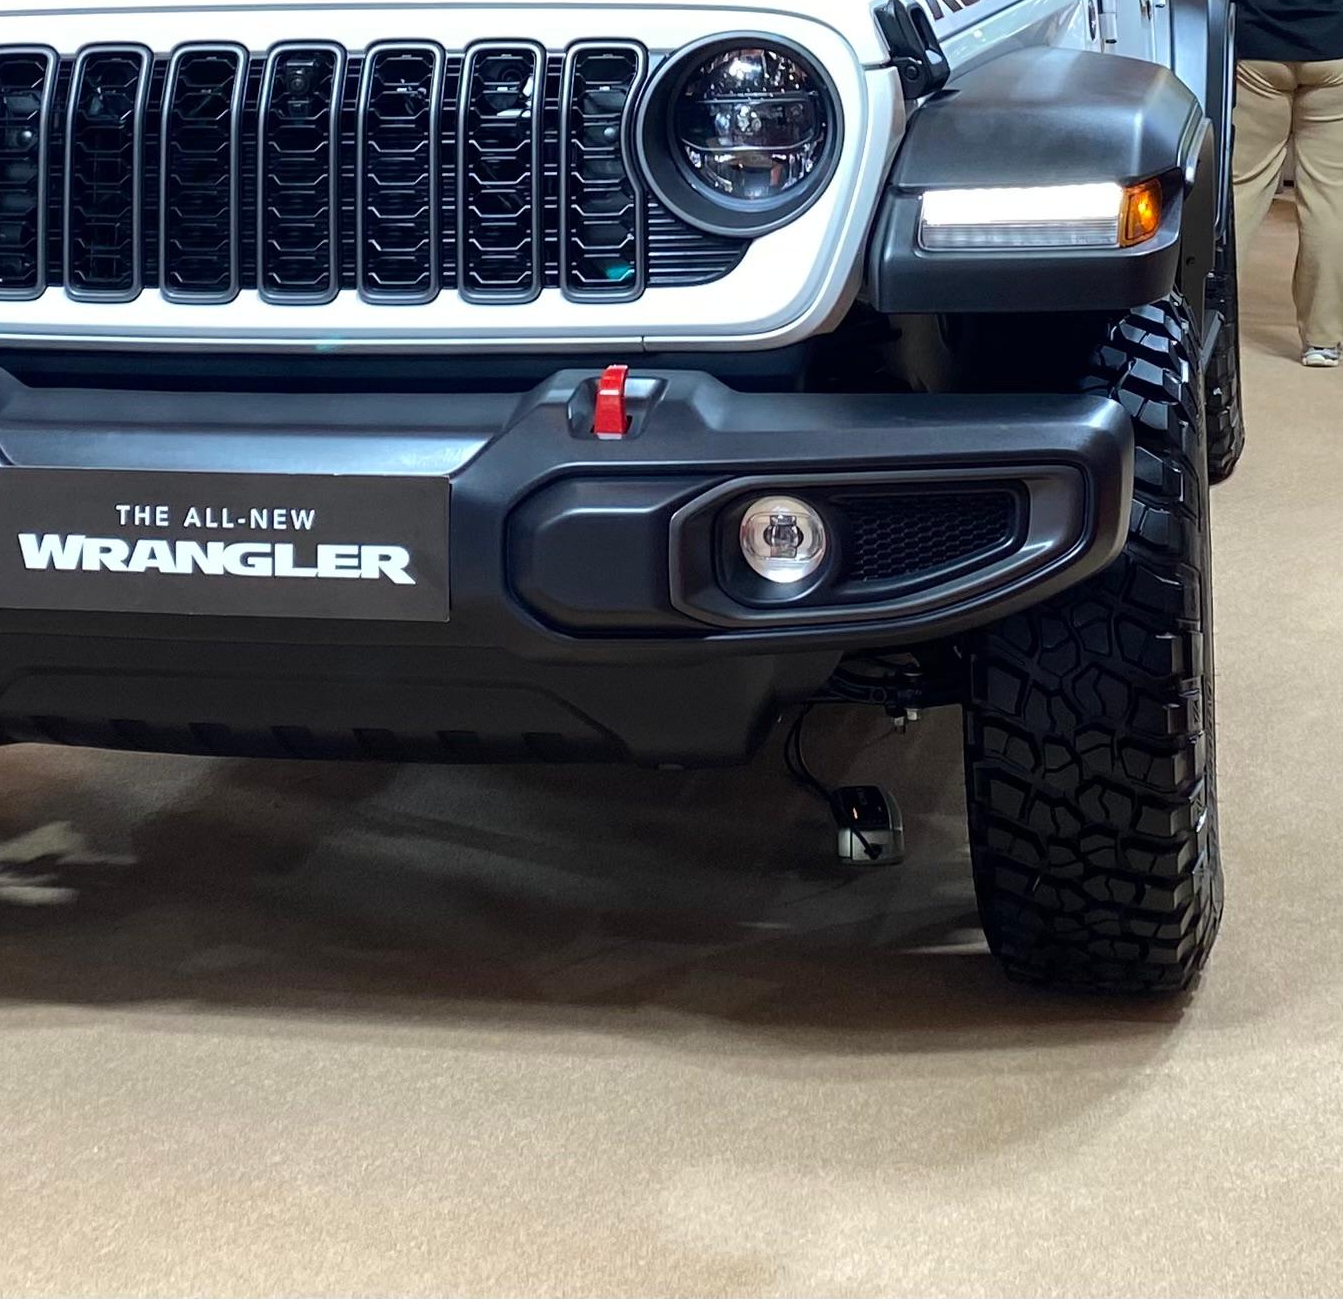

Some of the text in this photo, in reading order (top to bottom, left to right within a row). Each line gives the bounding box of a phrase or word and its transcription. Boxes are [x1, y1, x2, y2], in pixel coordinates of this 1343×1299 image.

[115, 504, 316, 531] THE ALL-NEW
[18, 532, 417, 585] WRANGLER
